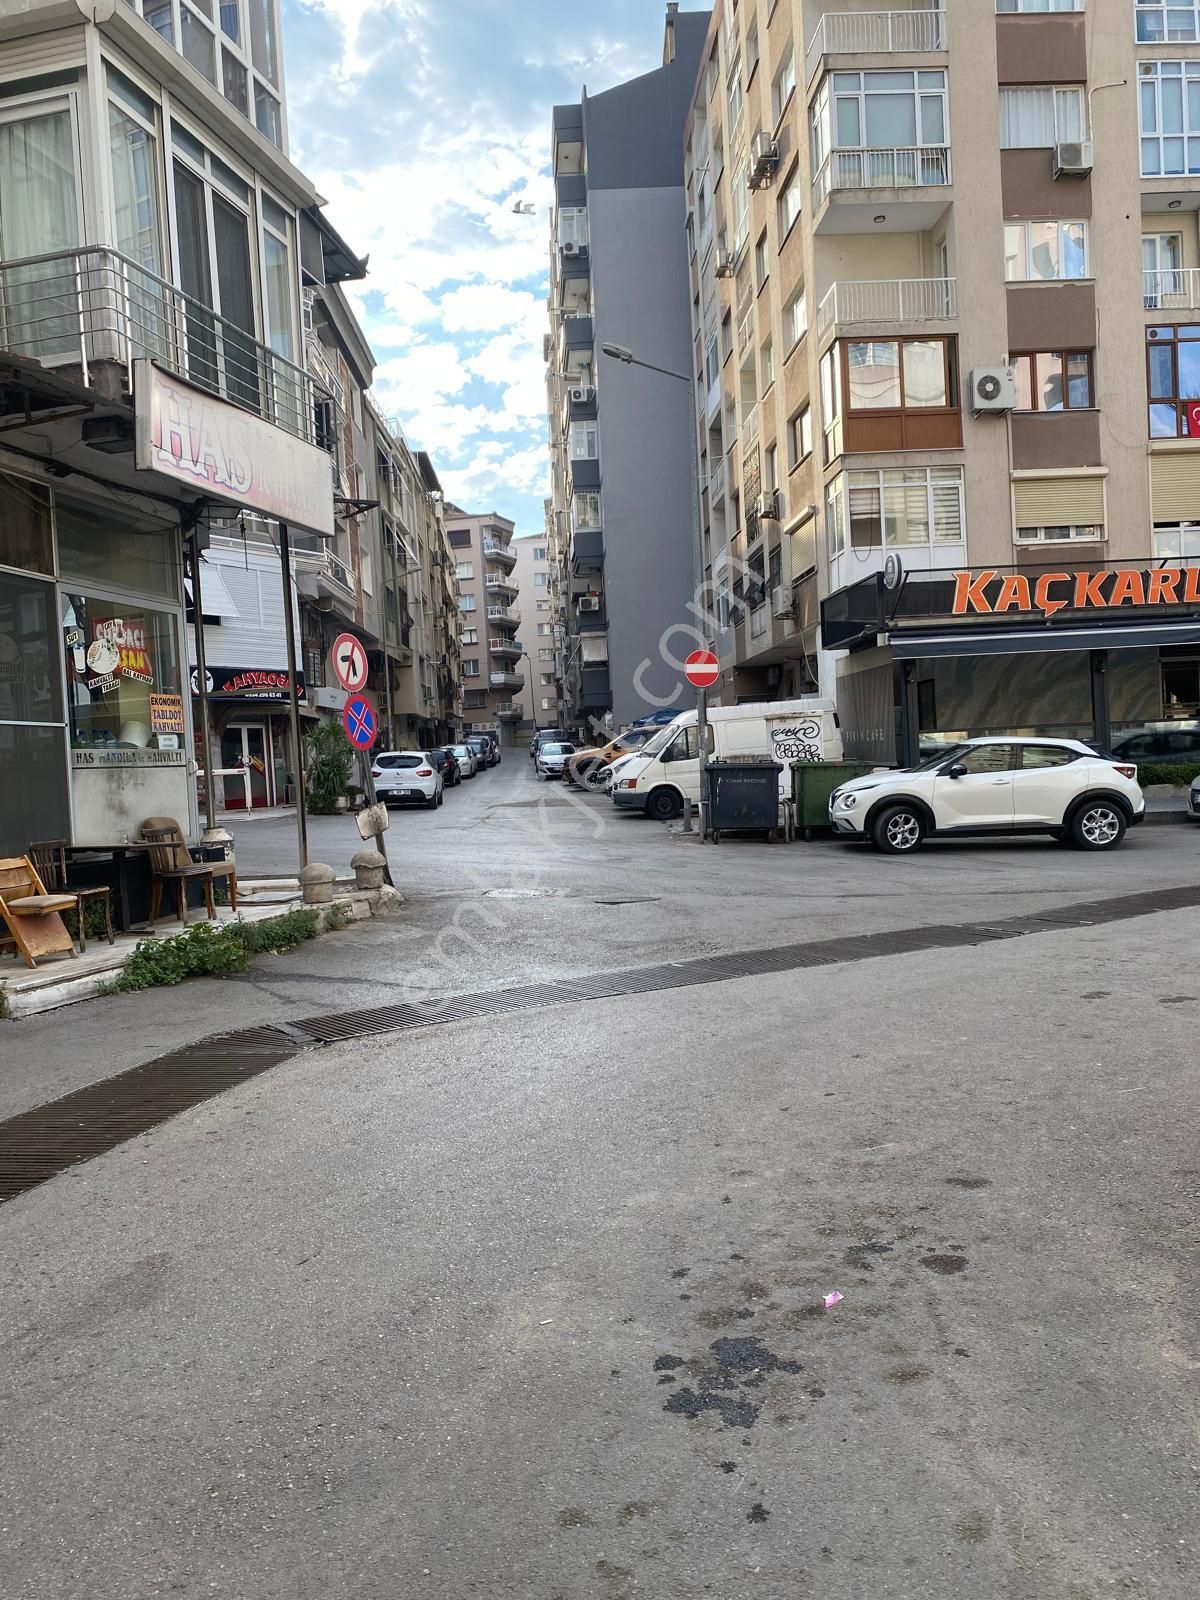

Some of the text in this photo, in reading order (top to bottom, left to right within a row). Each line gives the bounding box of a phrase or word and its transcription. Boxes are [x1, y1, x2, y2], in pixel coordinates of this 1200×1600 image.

[155, 382, 254, 495] HAS
[152, 709, 181, 721] TABLDOT
[153, 721, 183, 732] KAHVALTI
[76, 752, 94, 764] HAS
